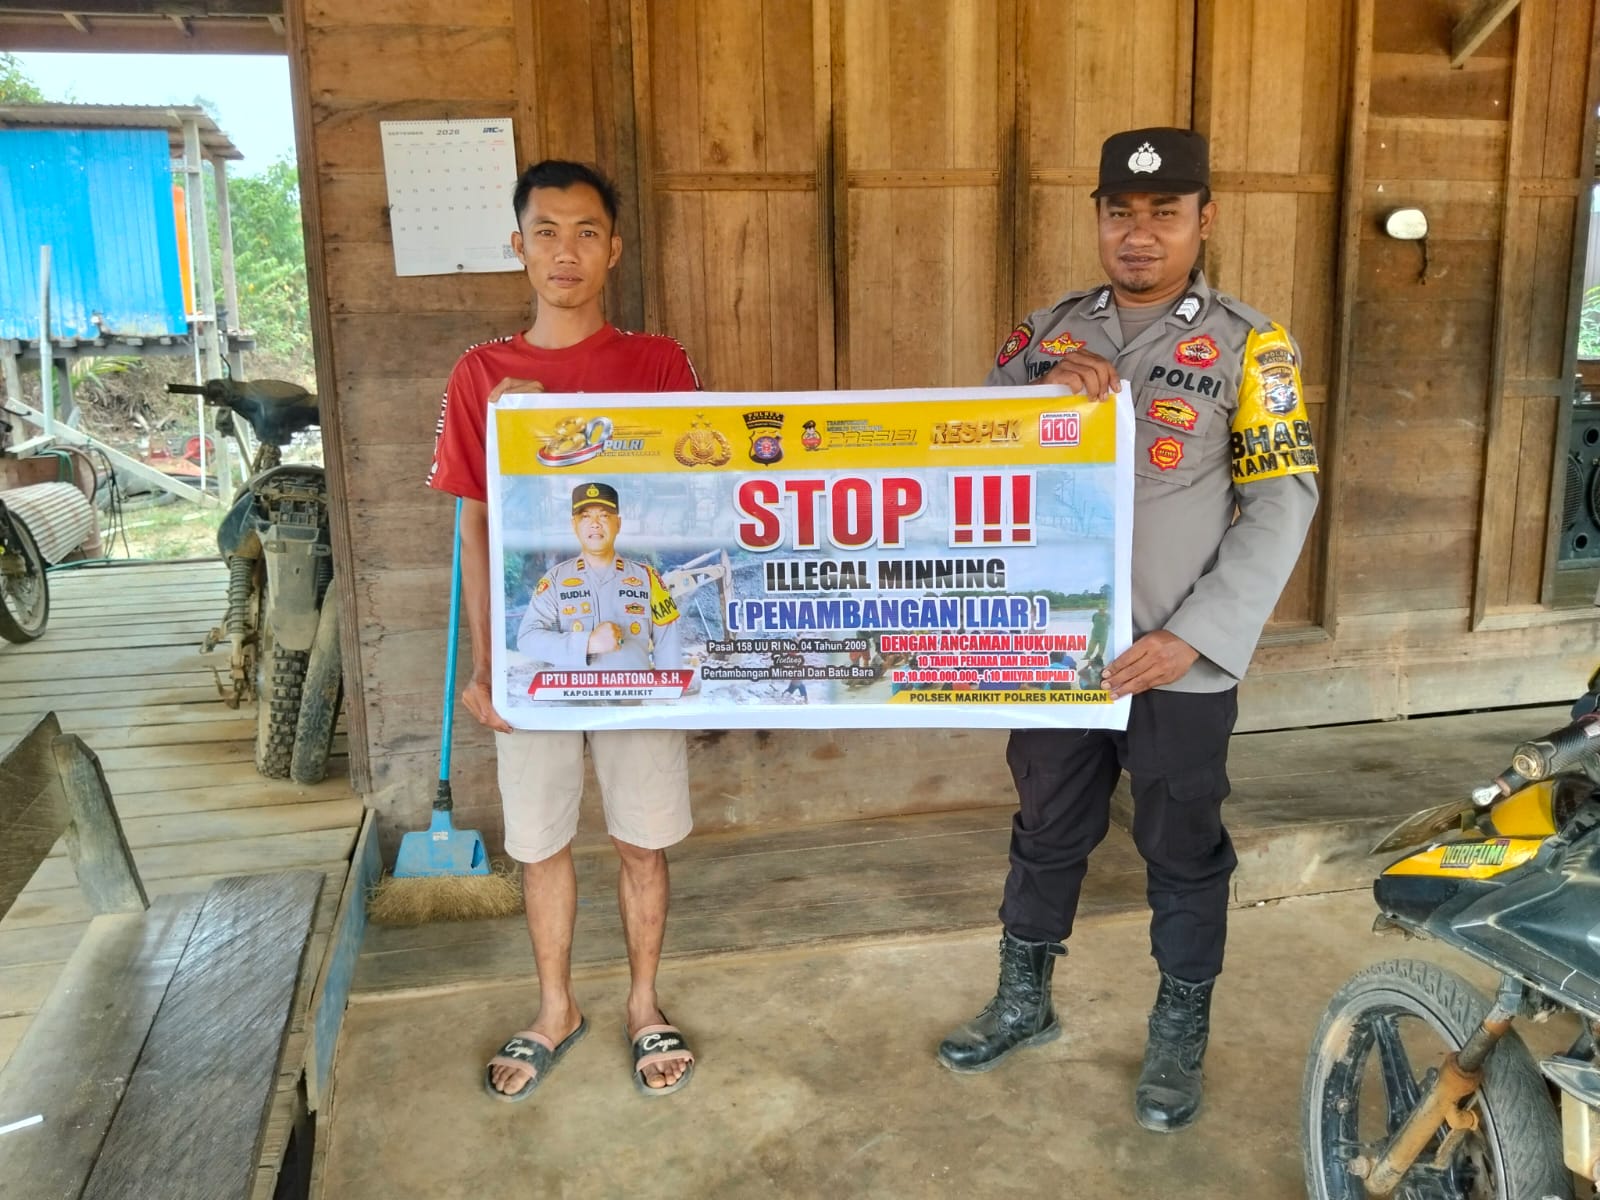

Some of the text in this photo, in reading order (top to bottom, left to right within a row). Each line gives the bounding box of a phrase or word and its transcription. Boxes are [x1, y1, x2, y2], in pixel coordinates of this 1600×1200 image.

[1150, 366, 1222, 398] POLRI
[932, 420, 1024, 444] RESPEK
[1042, 420, 1078, 439] 110
[603, 439, 645, 450] POLRI
[736, 474, 1033, 550] STOP !!!
[766, 559, 1006, 591] ILLEGAL MINNING
[619, 590, 649, 600] POLRI
[709, 641, 866, 651] Pasal 158 UU RI No. 04 Tahun 2009
[881, 635, 1087, 652] DENGAN ANCAMAN HUKUMAN
[929, 656, 959, 667] TAHUN
[961, 656, 999, 667] PENJARA
[1000, 656, 1018, 667] DAN
[1020, 656, 1049, 667] DENDA
[542, 673, 683, 685] IPTU BUDI HARTONO, S.H.
[703, 668, 874, 679] Pertambangan Mineral Dan Batu Bara
[1002, 671, 1034, 681] MILYAR
[910, 692, 1107, 702] POLSEK MARIKIT POLRES KATINGAN
